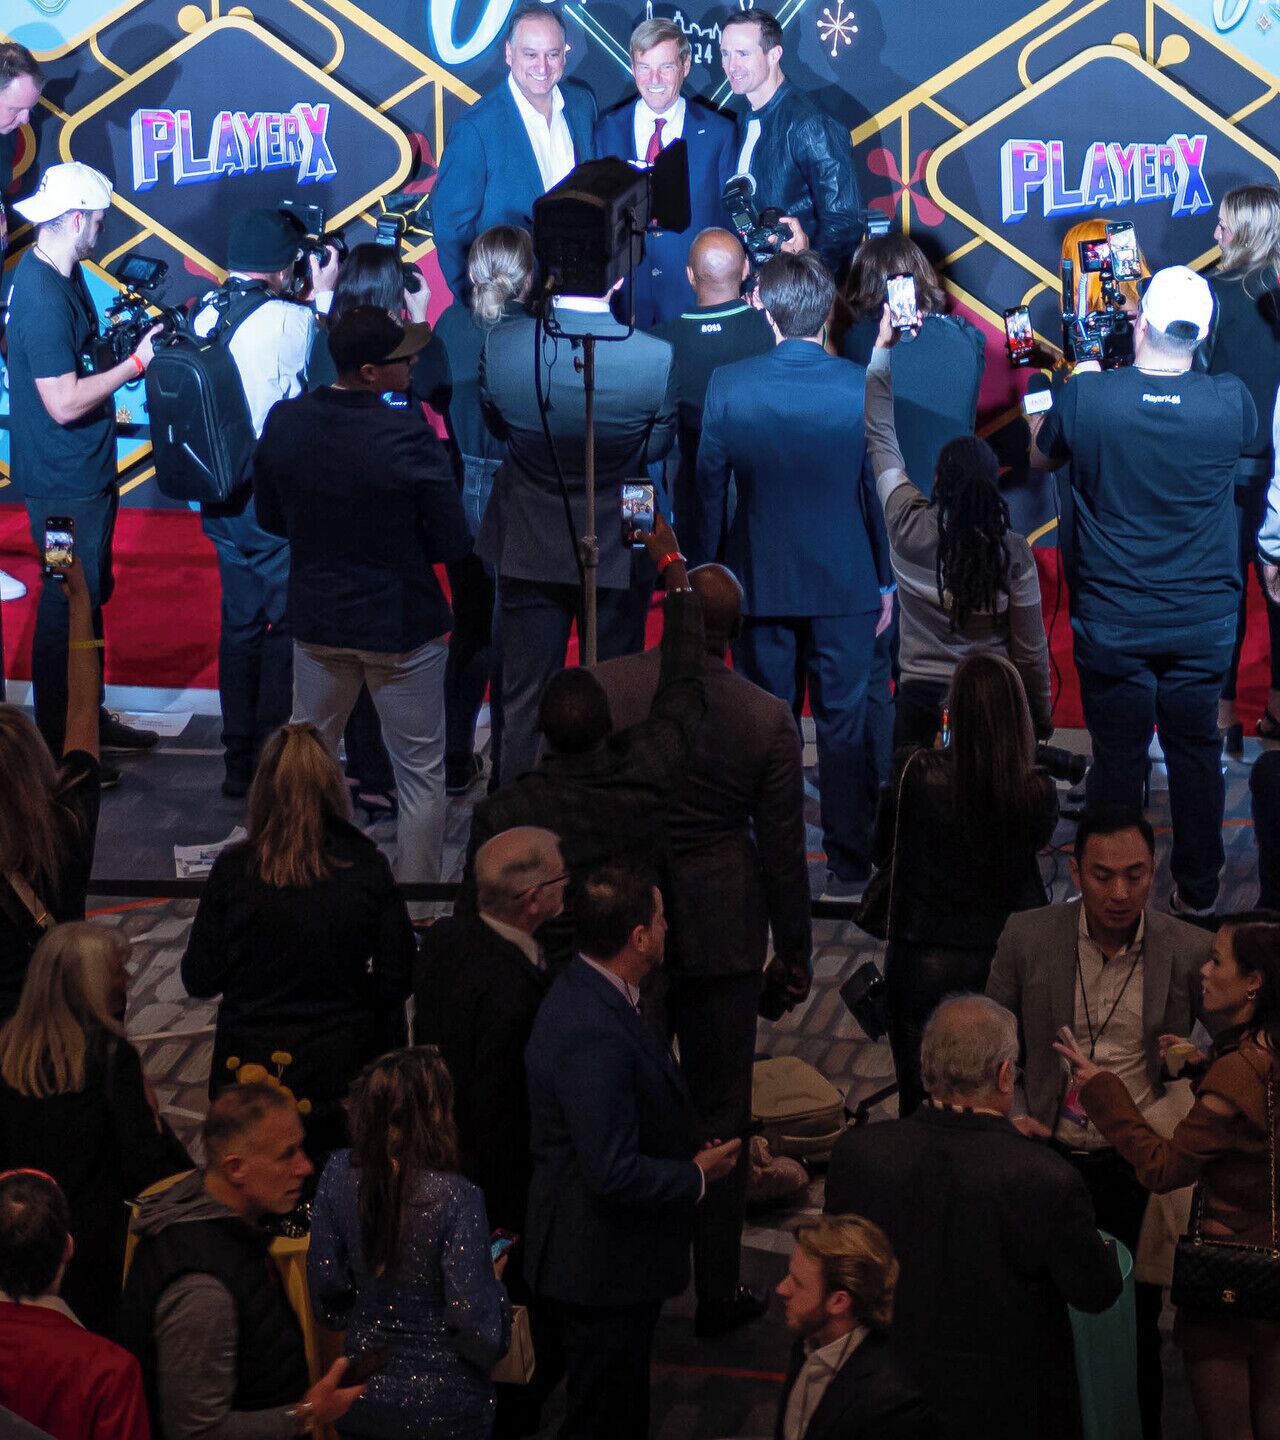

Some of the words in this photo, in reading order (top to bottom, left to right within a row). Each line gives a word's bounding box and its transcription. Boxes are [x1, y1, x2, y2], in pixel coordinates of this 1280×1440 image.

[690, 43, 713, 64] 24
[131, 102, 338, 192] PLAYERX
[1000, 133, 1214, 224] PLAYERX
